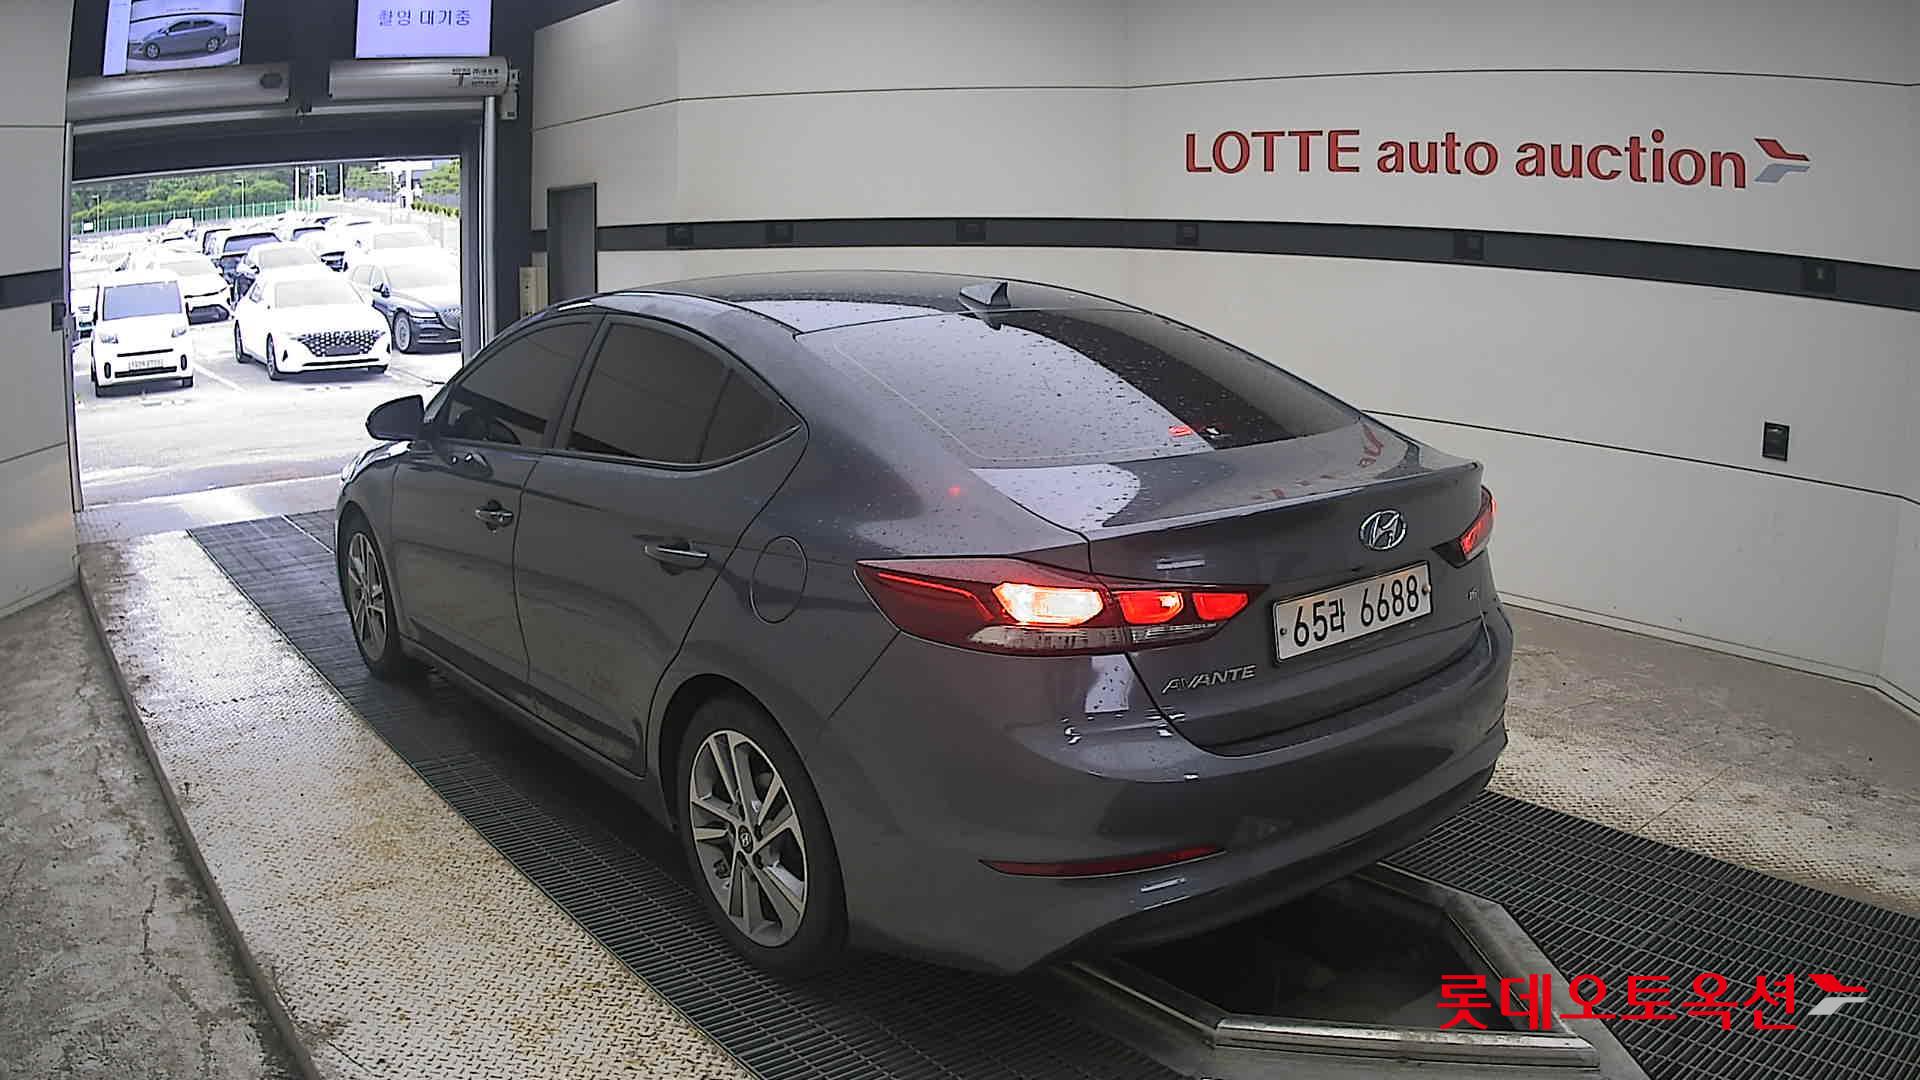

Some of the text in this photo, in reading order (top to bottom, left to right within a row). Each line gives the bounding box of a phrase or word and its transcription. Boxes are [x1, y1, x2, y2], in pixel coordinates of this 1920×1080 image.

[420, 9, 471, 26] 대기중
[1185, 129, 1746, 189] LOTTE auto auction
[1293, 574, 1420, 648] 65라 6688
[1162, 664, 1257, 694] AVANTE
